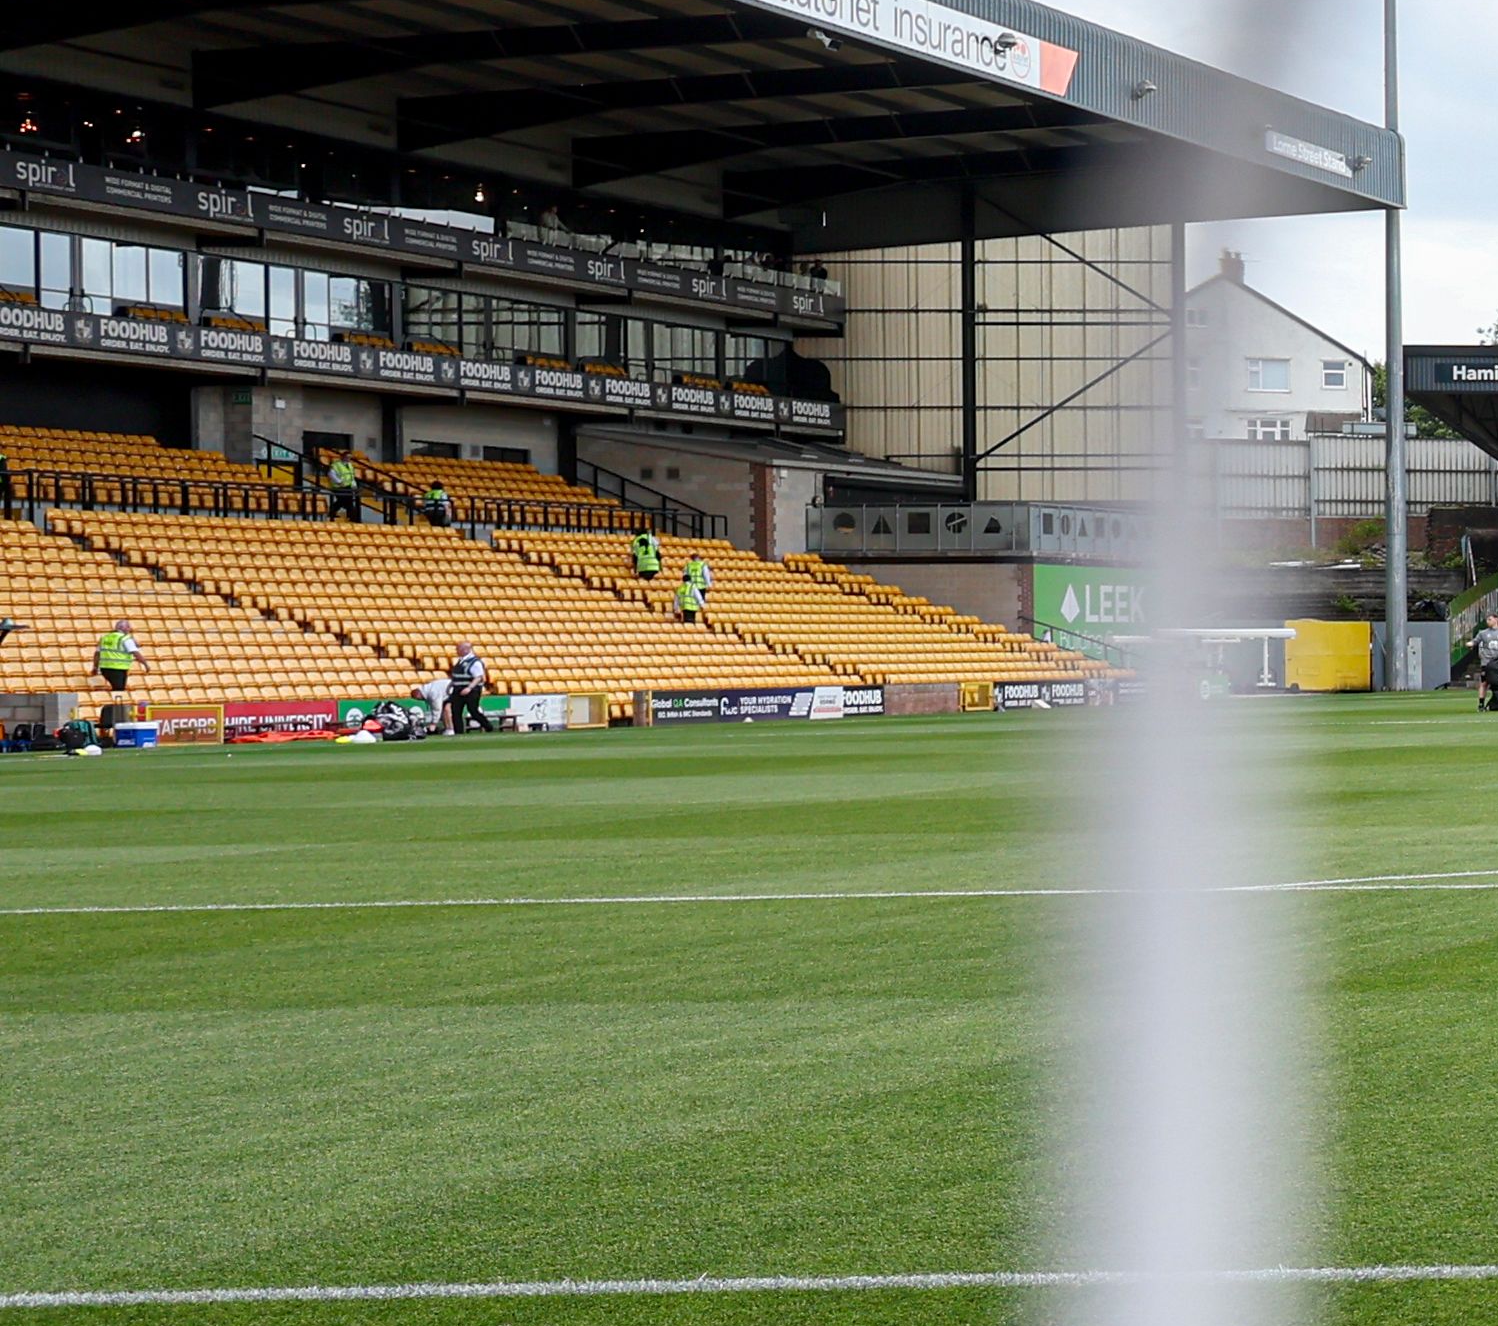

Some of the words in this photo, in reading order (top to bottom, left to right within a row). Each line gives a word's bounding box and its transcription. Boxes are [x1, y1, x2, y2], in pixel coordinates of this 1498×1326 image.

[0, 306, 65, 332] OODHUB
[100, 318, 168, 343] FOODHUB
[200, 329, 263, 353] FOODHUB
[293, 340, 351, 363] FOODHUB
[379, 351, 433, 373] FOODHUB
[460, 361, 510, 381] FOODHUB
[535, 370, 582, 389] FOODHUB
[605, 378, 650, 397] FOODHUB
[671, 386, 714, 405] FOODHUB
[734, 394, 774, 411] FOODHUB
[792, 400, 830, 418] FOODHUB
[1085, 584, 1145, 623] LEEK
[739, 696, 756, 705] YOUR
[758, 695, 791, 705] HYDRATION
[842, 689, 882, 705] FOODHUB
[1005, 684, 1039, 700] FOODHUB
[1052, 684, 1084, 698] FOODHUB
[652, 698, 672, 709] Global
[739, 705, 778, 715] SPECIALISTS
